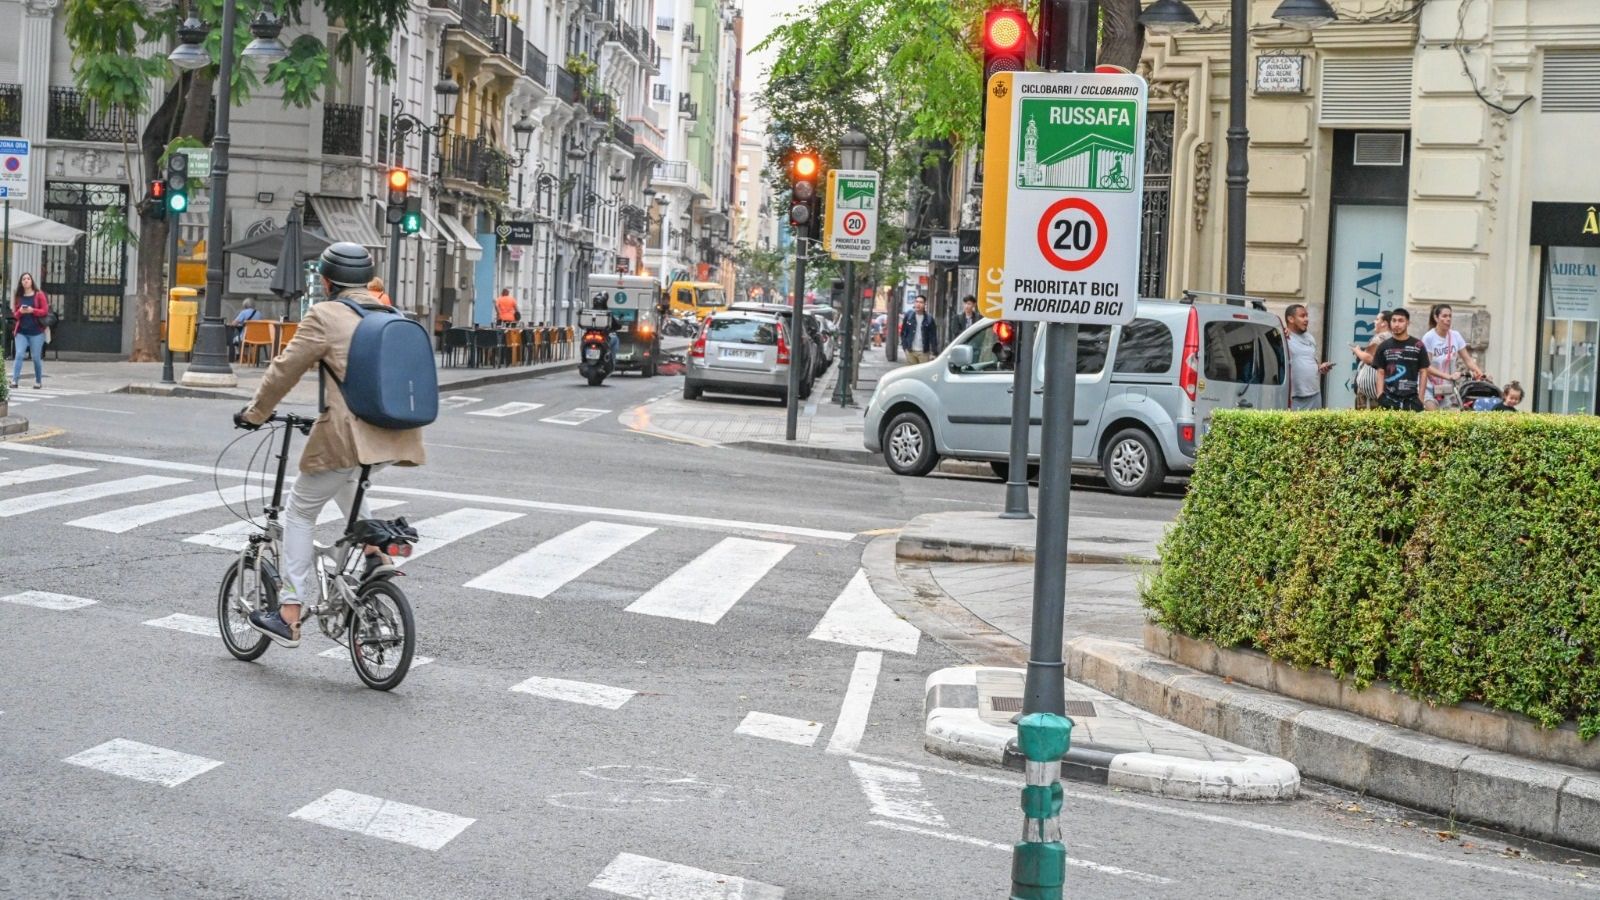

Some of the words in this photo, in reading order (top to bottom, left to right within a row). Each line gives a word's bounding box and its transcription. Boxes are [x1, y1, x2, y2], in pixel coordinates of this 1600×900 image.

[1021, 84, 1072, 94] CICLOBARRI
[1081, 86, 1139, 96] CICLOBARRIO
[1050, 106, 1130, 126] RUSSAFA
[847, 181, 874, 189] RUSSAFA
[848, 218, 861, 230] 20
[1582, 205, 1600, 234] Â
[1053, 219, 1091, 250] 20
[986, 267, 1004, 314] VLC
[1014, 279, 1087, 295] PRIORITAT
[1091, 282, 1119, 297] BICI
[1014, 298, 1091, 314] PRIORIDAD
[1093, 301, 1123, 316] BICI
